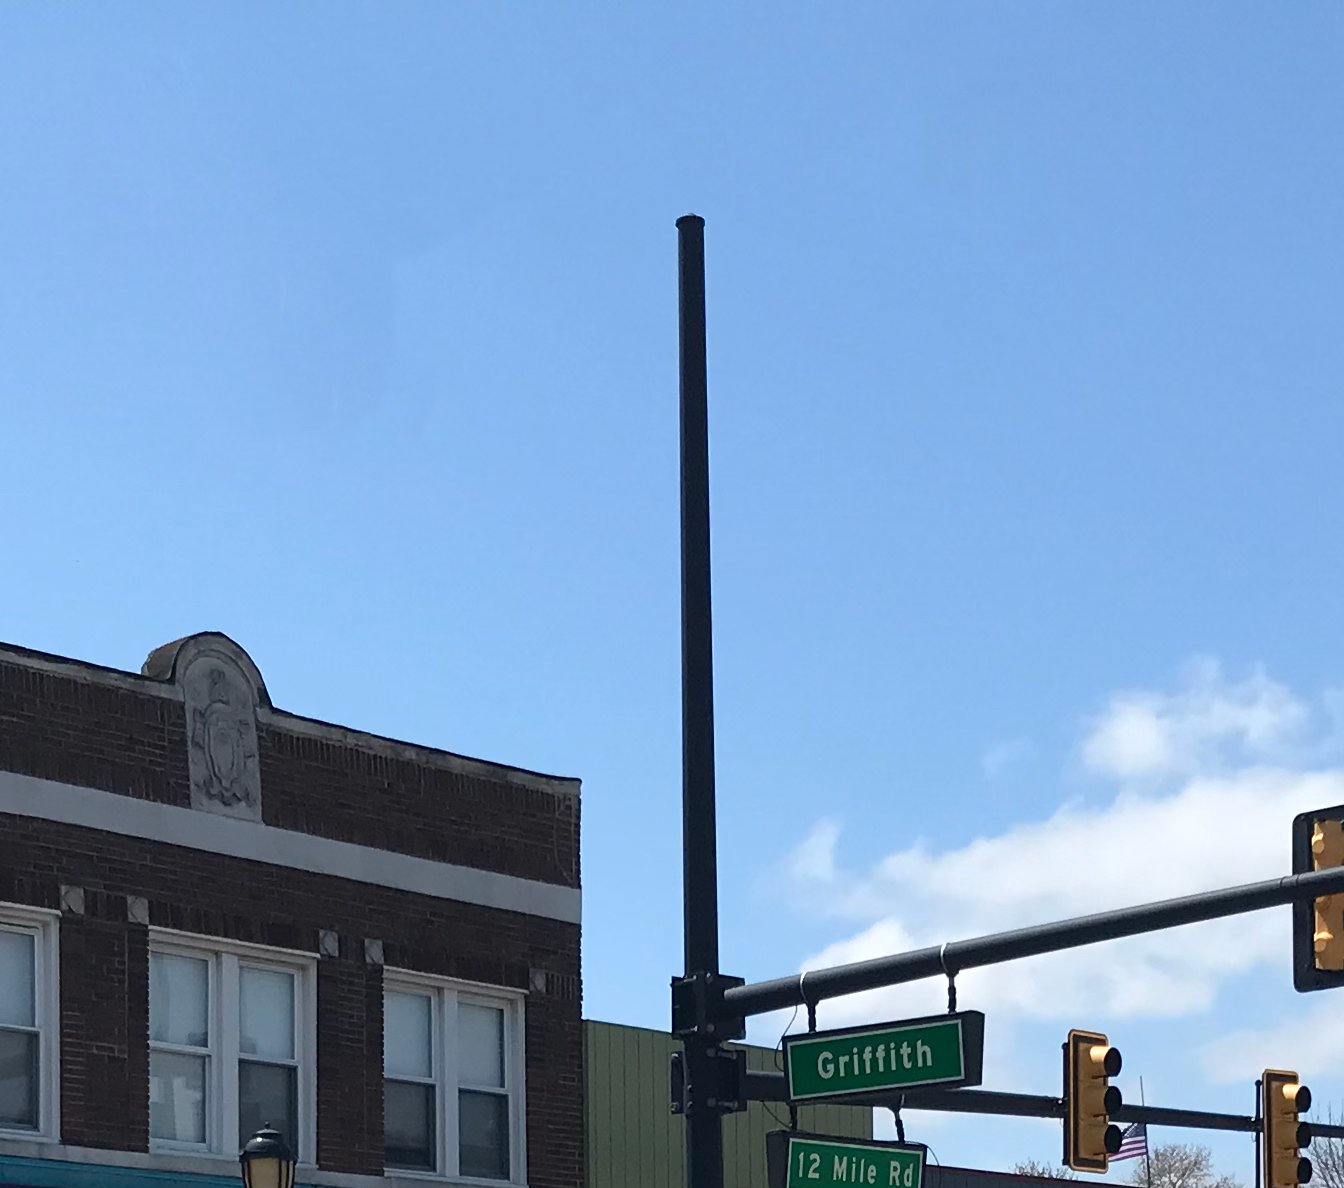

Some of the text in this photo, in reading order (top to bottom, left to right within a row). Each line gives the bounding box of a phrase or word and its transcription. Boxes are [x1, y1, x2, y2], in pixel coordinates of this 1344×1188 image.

[817, 1040, 932, 1079] Griffith
[798, 1152, 914, 1187] 12 Mile Rd
